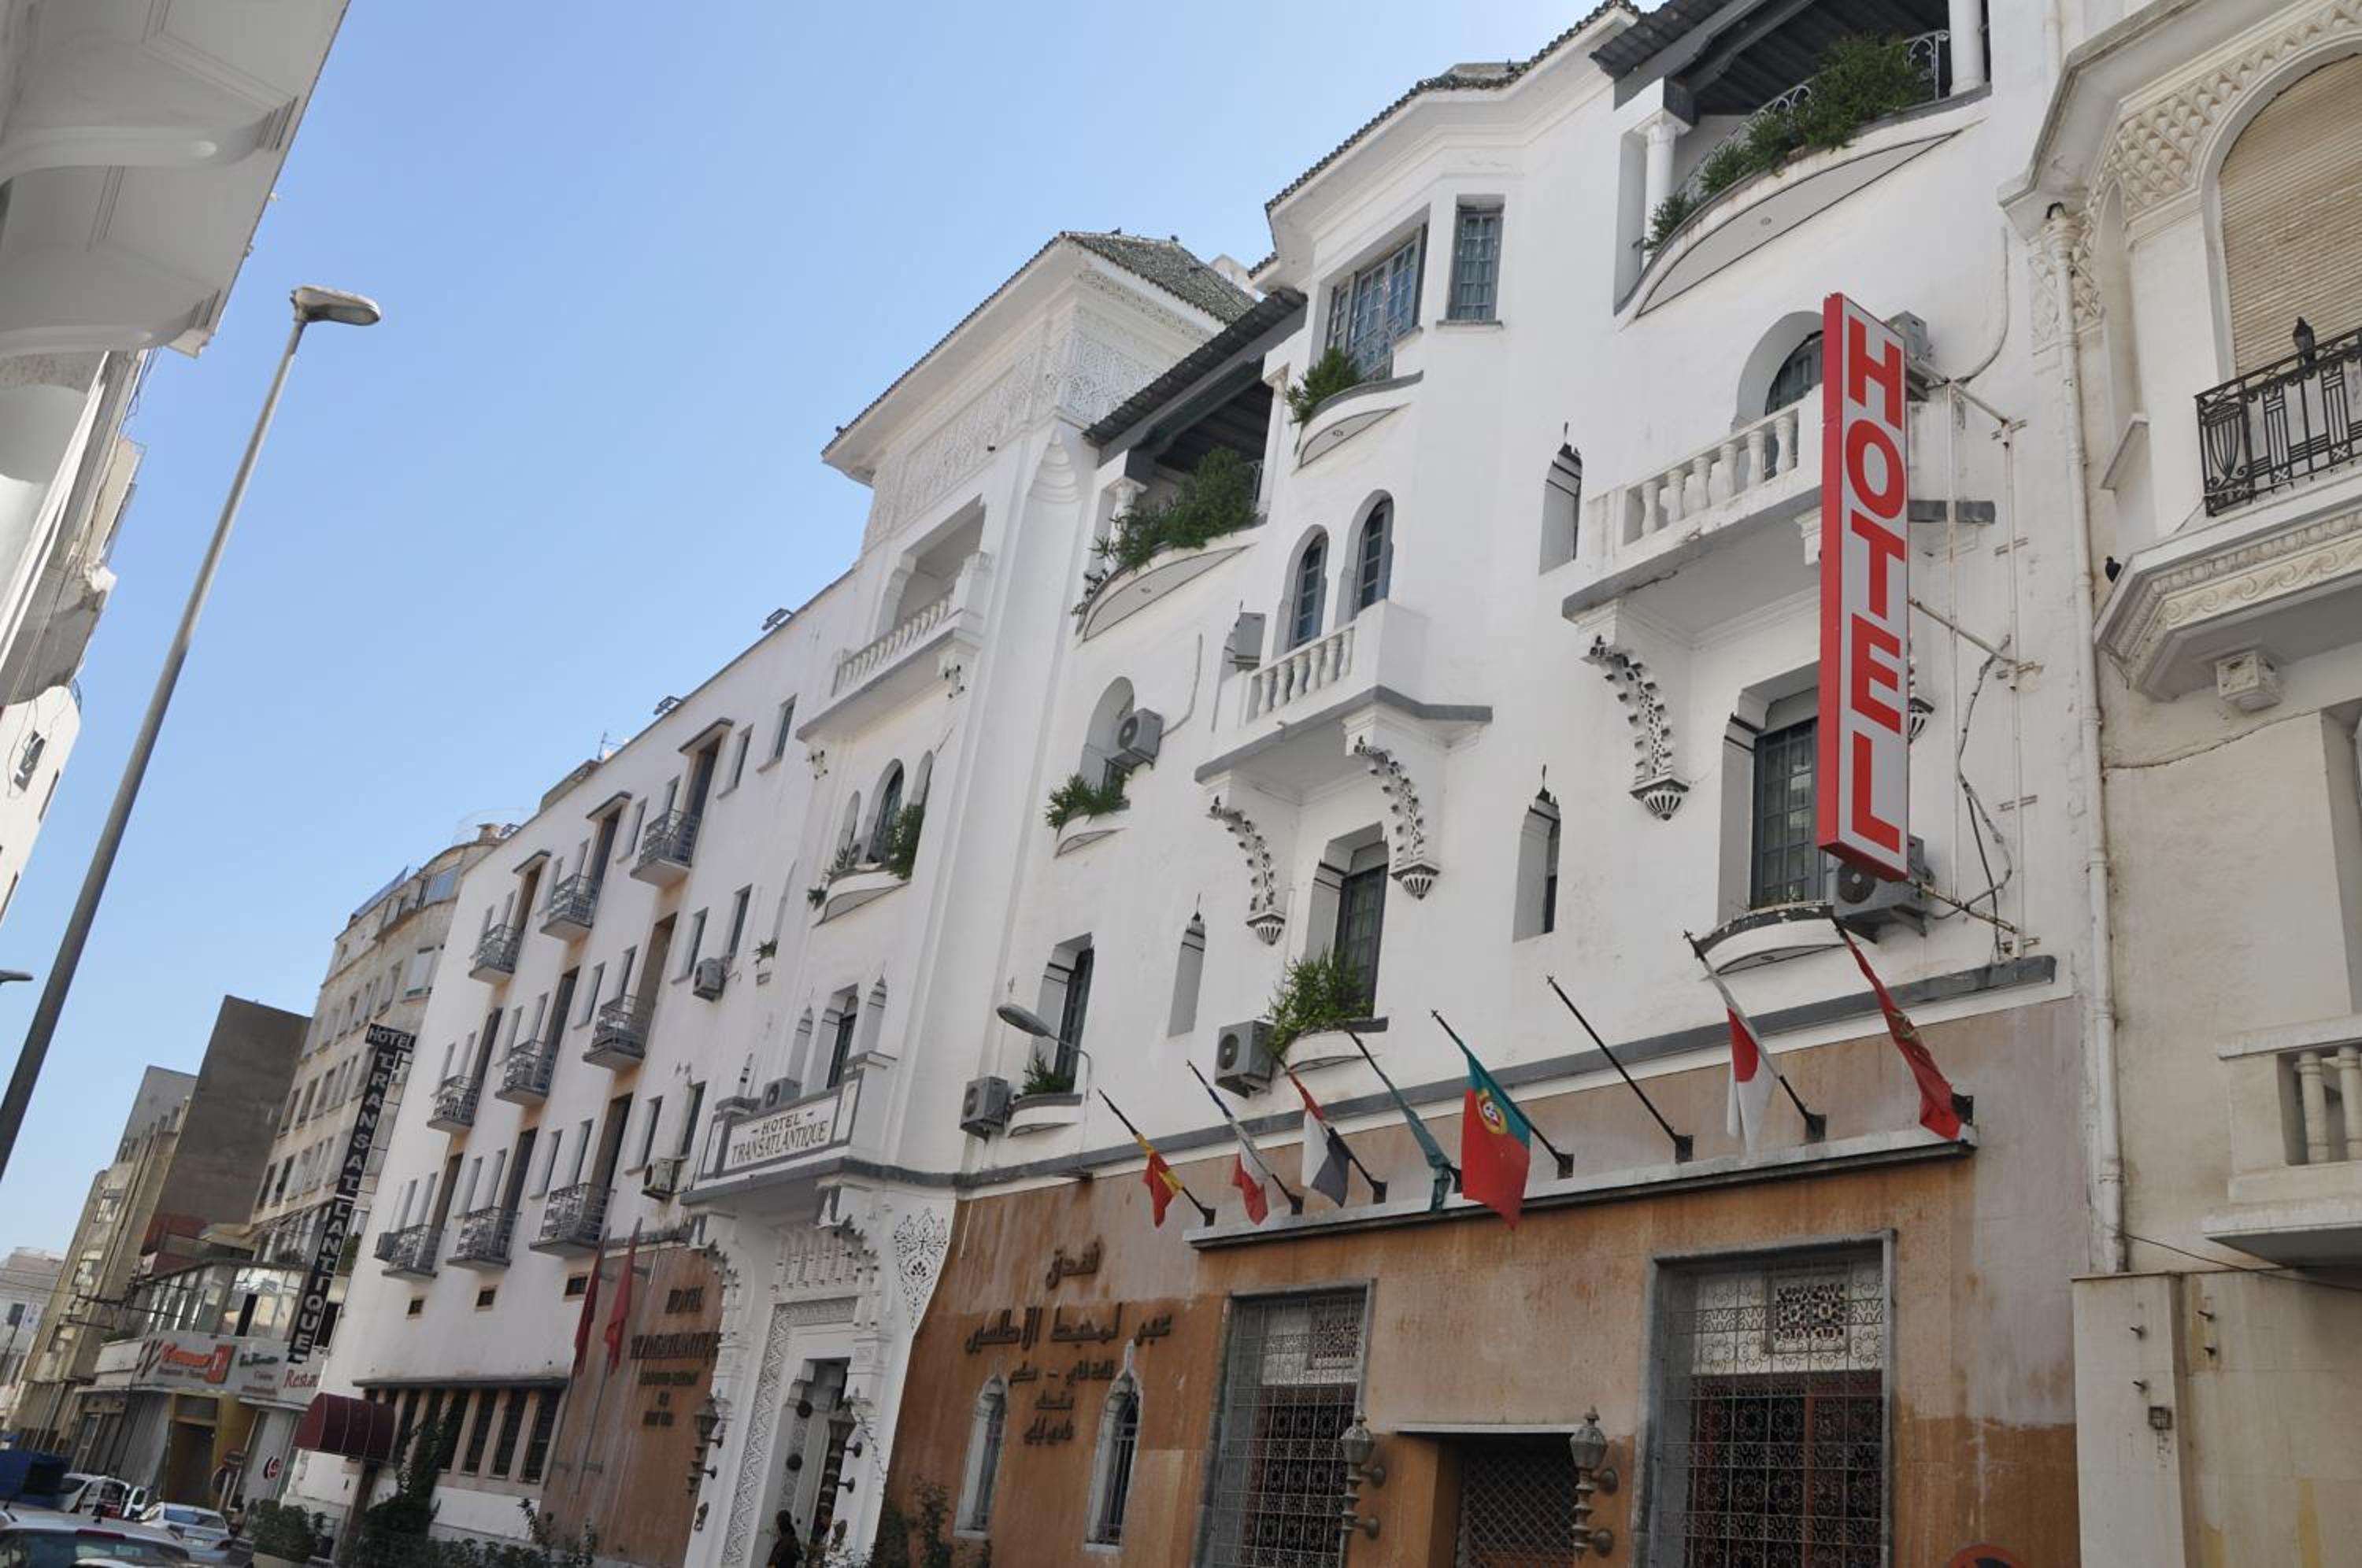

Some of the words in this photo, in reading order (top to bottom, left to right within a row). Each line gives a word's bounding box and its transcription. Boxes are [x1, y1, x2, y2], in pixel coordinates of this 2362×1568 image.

[1845, 315, 1907, 854] HOTEL
[368, 1026, 415, 1048] HOTEL
[761, 1112, 801, 1135] HOTEL
[731, 1120, 829, 1165] TRANSATLANTIQUE
[283, 1369, 319, 1388] Resta
